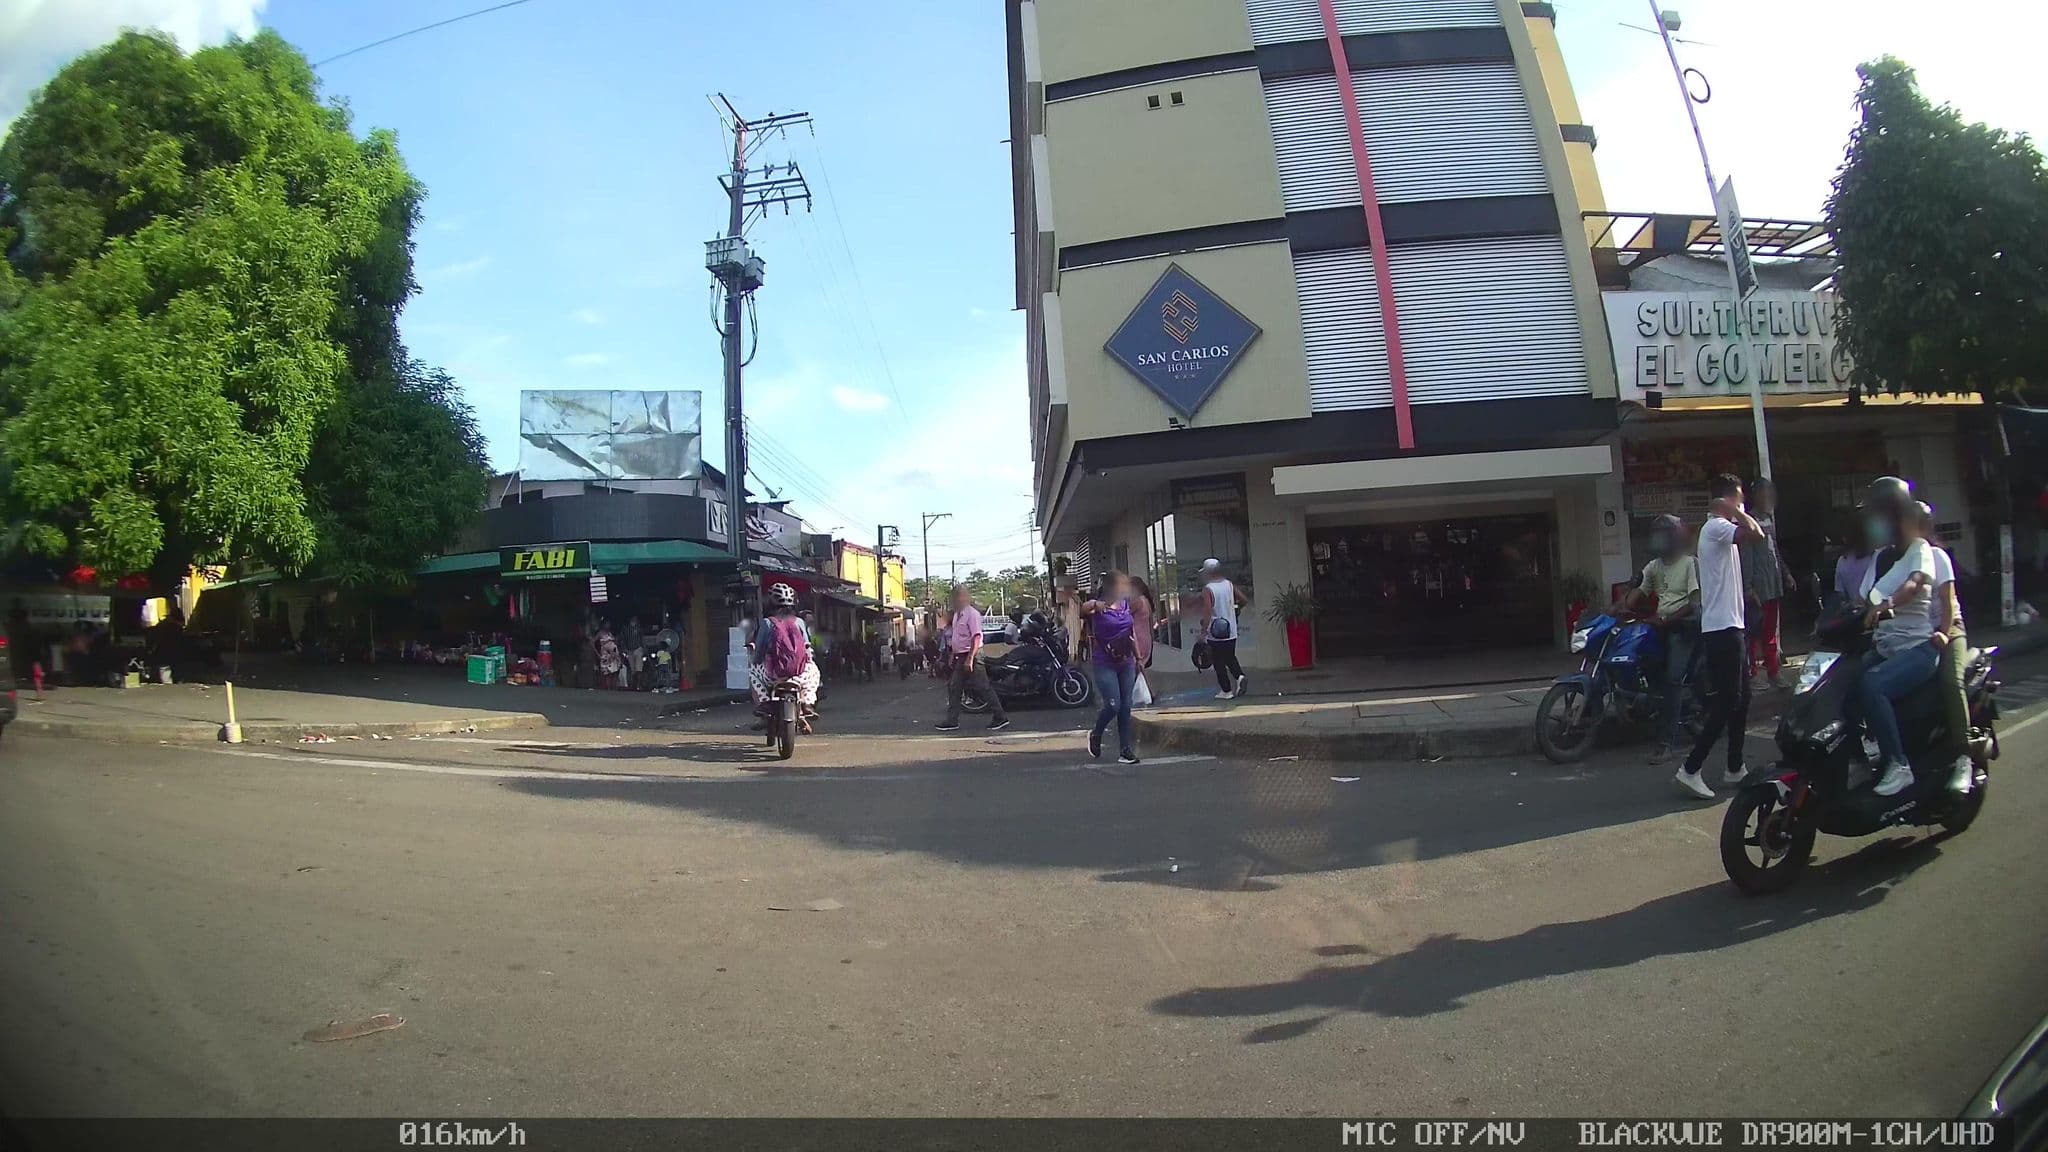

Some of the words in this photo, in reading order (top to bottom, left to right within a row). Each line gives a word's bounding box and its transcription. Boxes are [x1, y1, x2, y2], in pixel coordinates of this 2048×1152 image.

[1636, 301, 1841, 338] SURTIFRUV
[1137, 351, 1166, 366] SAN
[1171, 345, 1229, 362] CARLOS
[1636, 344, 1685, 387] EL
[1696, 343, 1852, 385] COMERC
[1167, 361, 1203, 373] HOTEL
[513, 549, 576, 571] FABI
